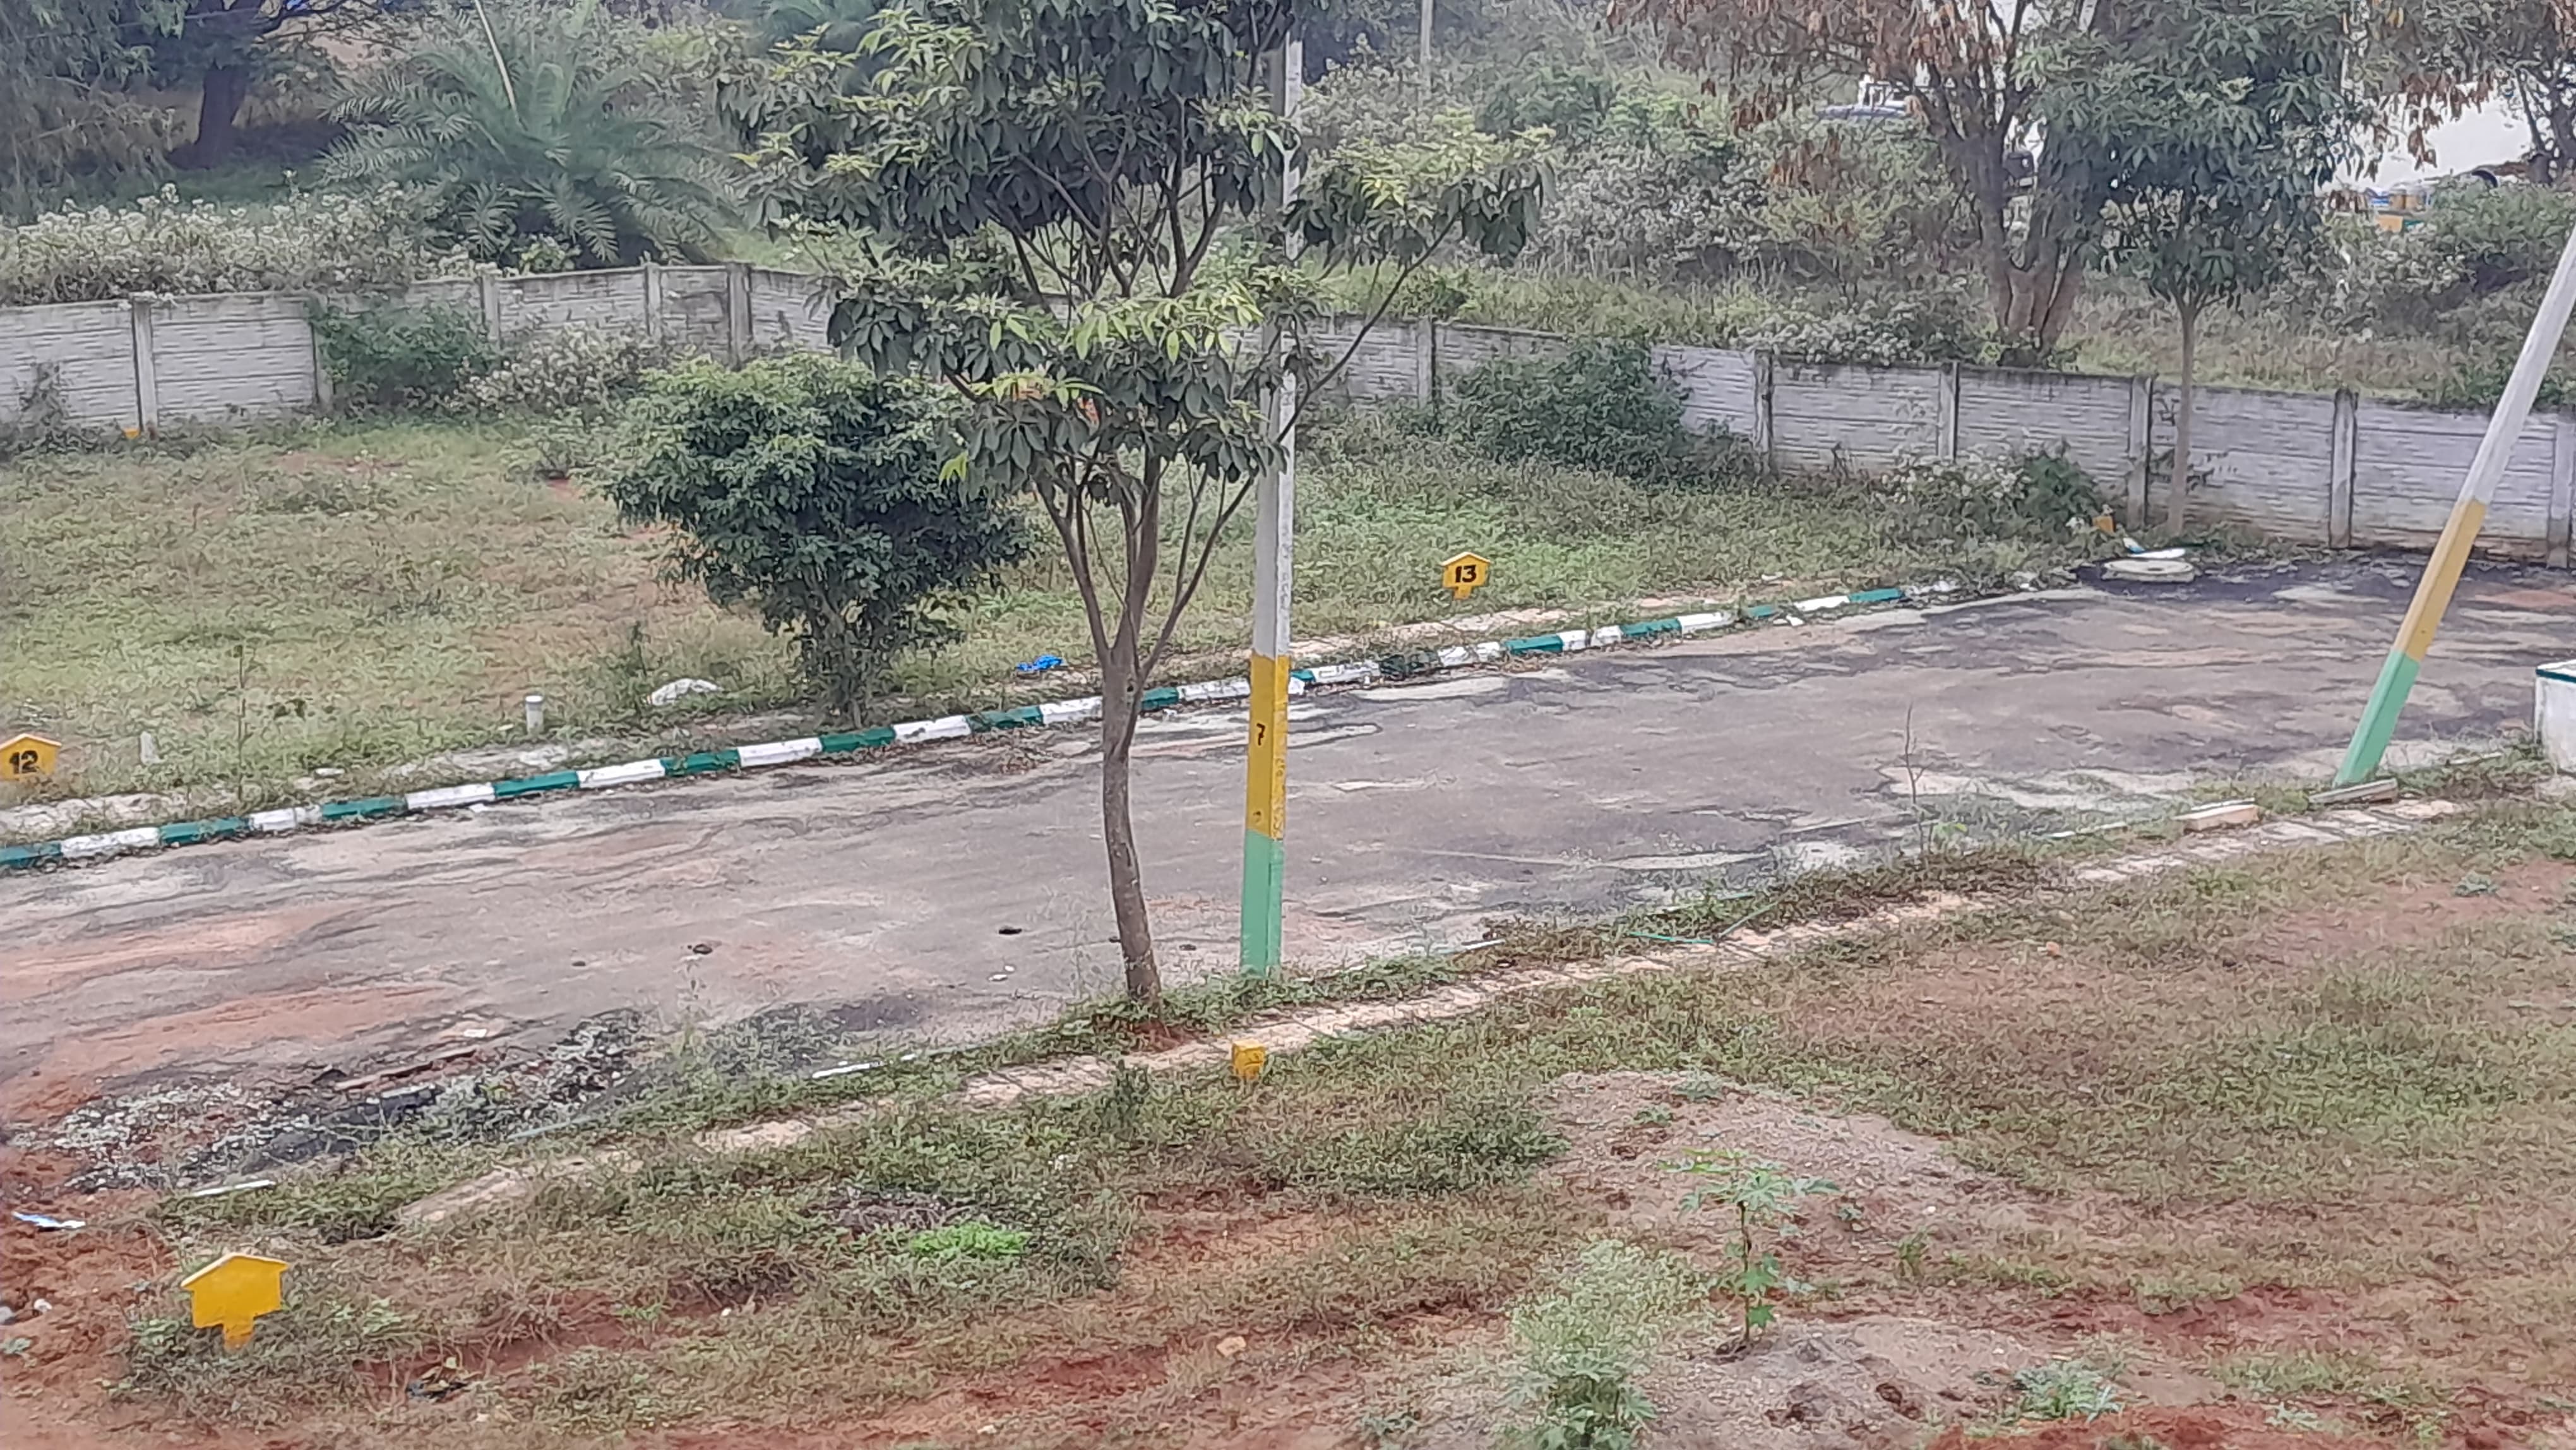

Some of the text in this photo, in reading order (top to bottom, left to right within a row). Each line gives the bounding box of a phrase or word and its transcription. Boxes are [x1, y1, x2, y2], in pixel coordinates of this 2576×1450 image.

[1455, 564, 1476, 583] 13
[1256, 722, 1265, 746] 7
[9, 750, 39, 774] 12
